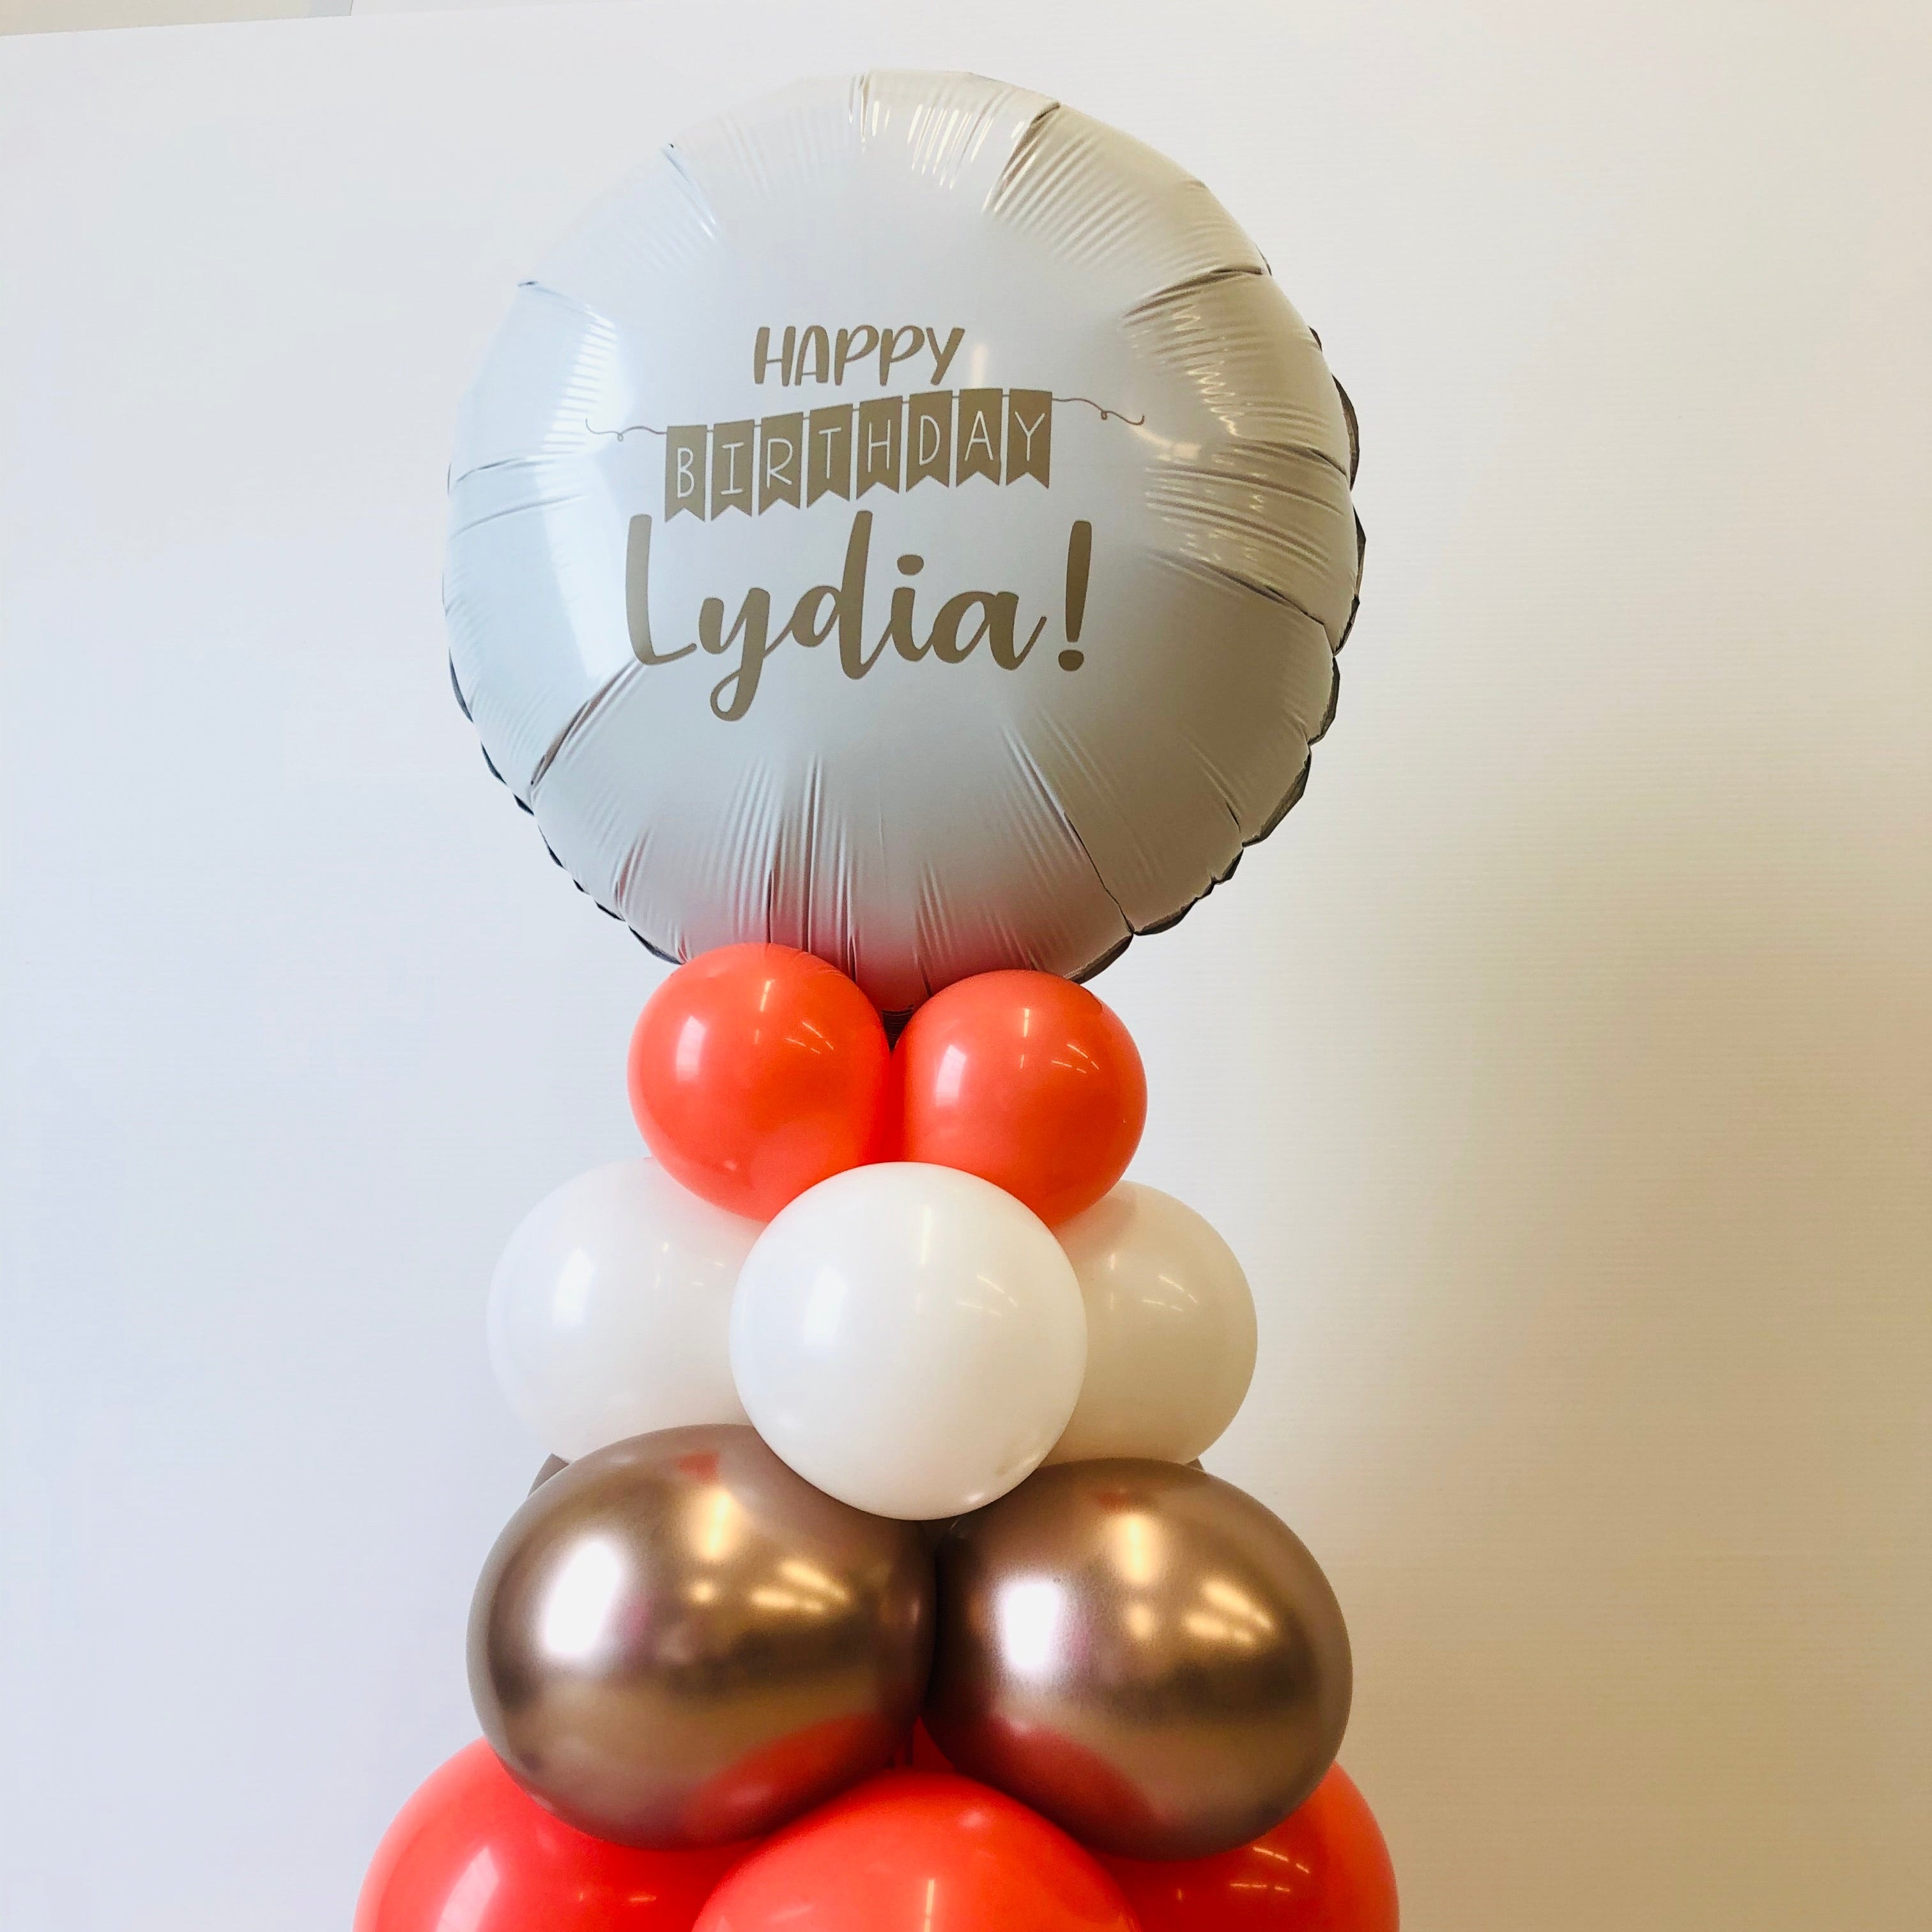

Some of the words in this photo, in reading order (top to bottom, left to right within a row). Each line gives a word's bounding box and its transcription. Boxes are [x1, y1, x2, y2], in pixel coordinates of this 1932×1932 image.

[753, 325, 966, 386] HAPPY
[675, 410, 1047, 499] BIRTHDAY
[625, 510, 1092, 721] Lydia!
